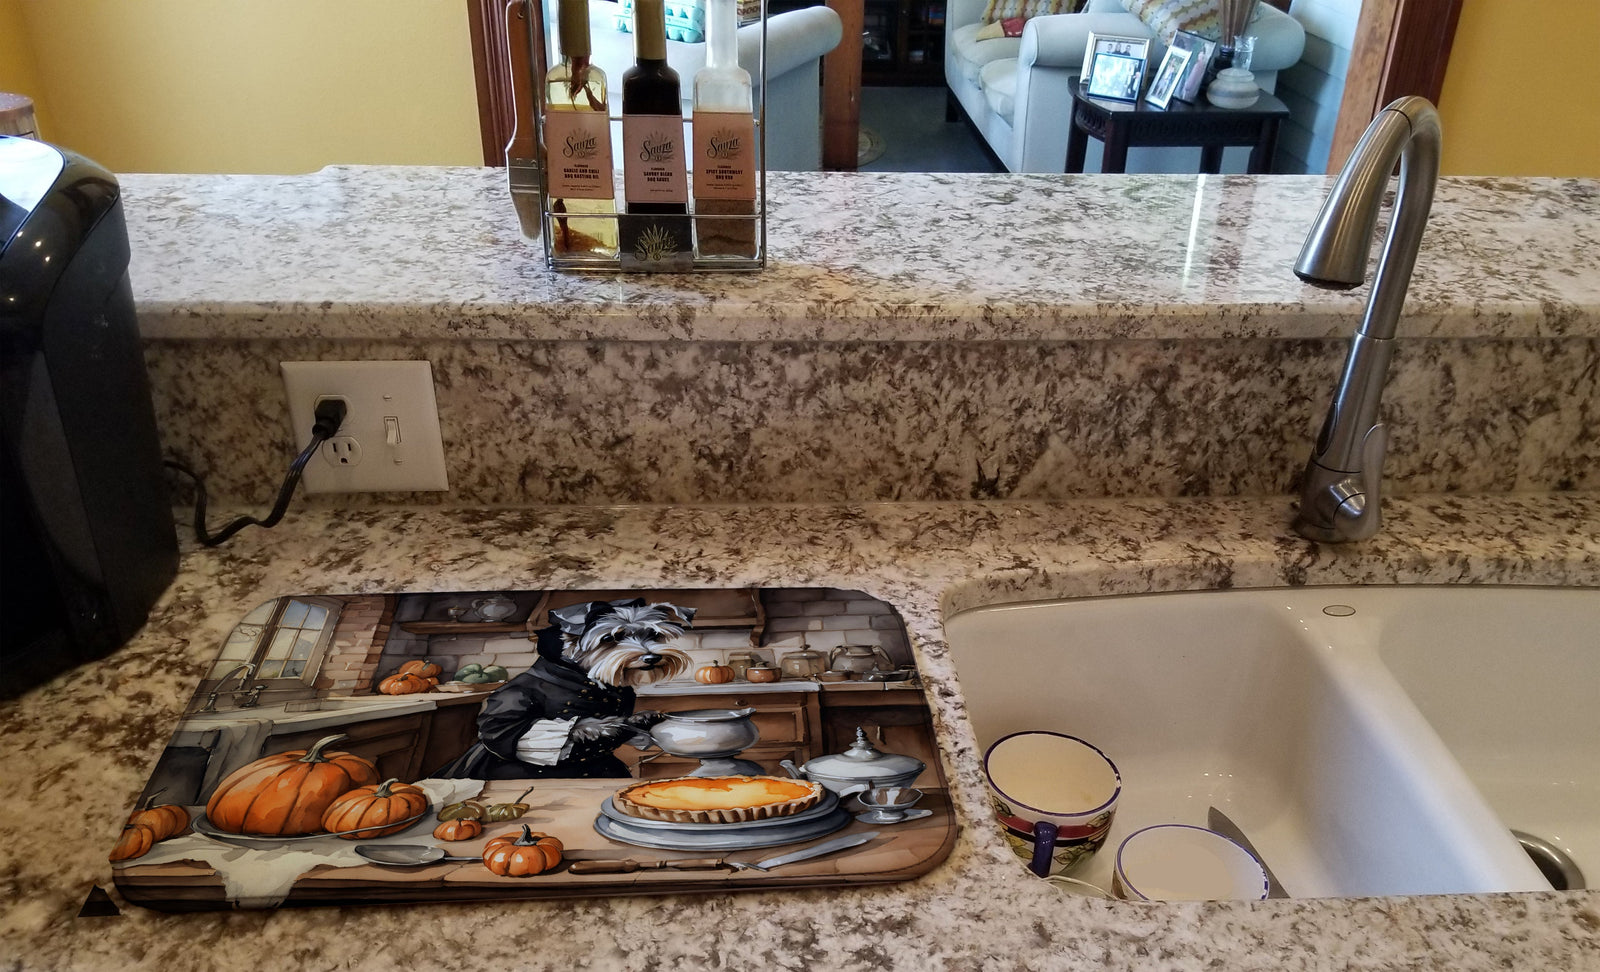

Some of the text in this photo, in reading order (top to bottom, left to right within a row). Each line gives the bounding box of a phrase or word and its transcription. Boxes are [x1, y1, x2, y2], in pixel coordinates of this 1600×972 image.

[563, 136, 597, 158] Sauza
[640, 140, 673, 162] Sauza
[707, 137, 739, 159] Sauza
